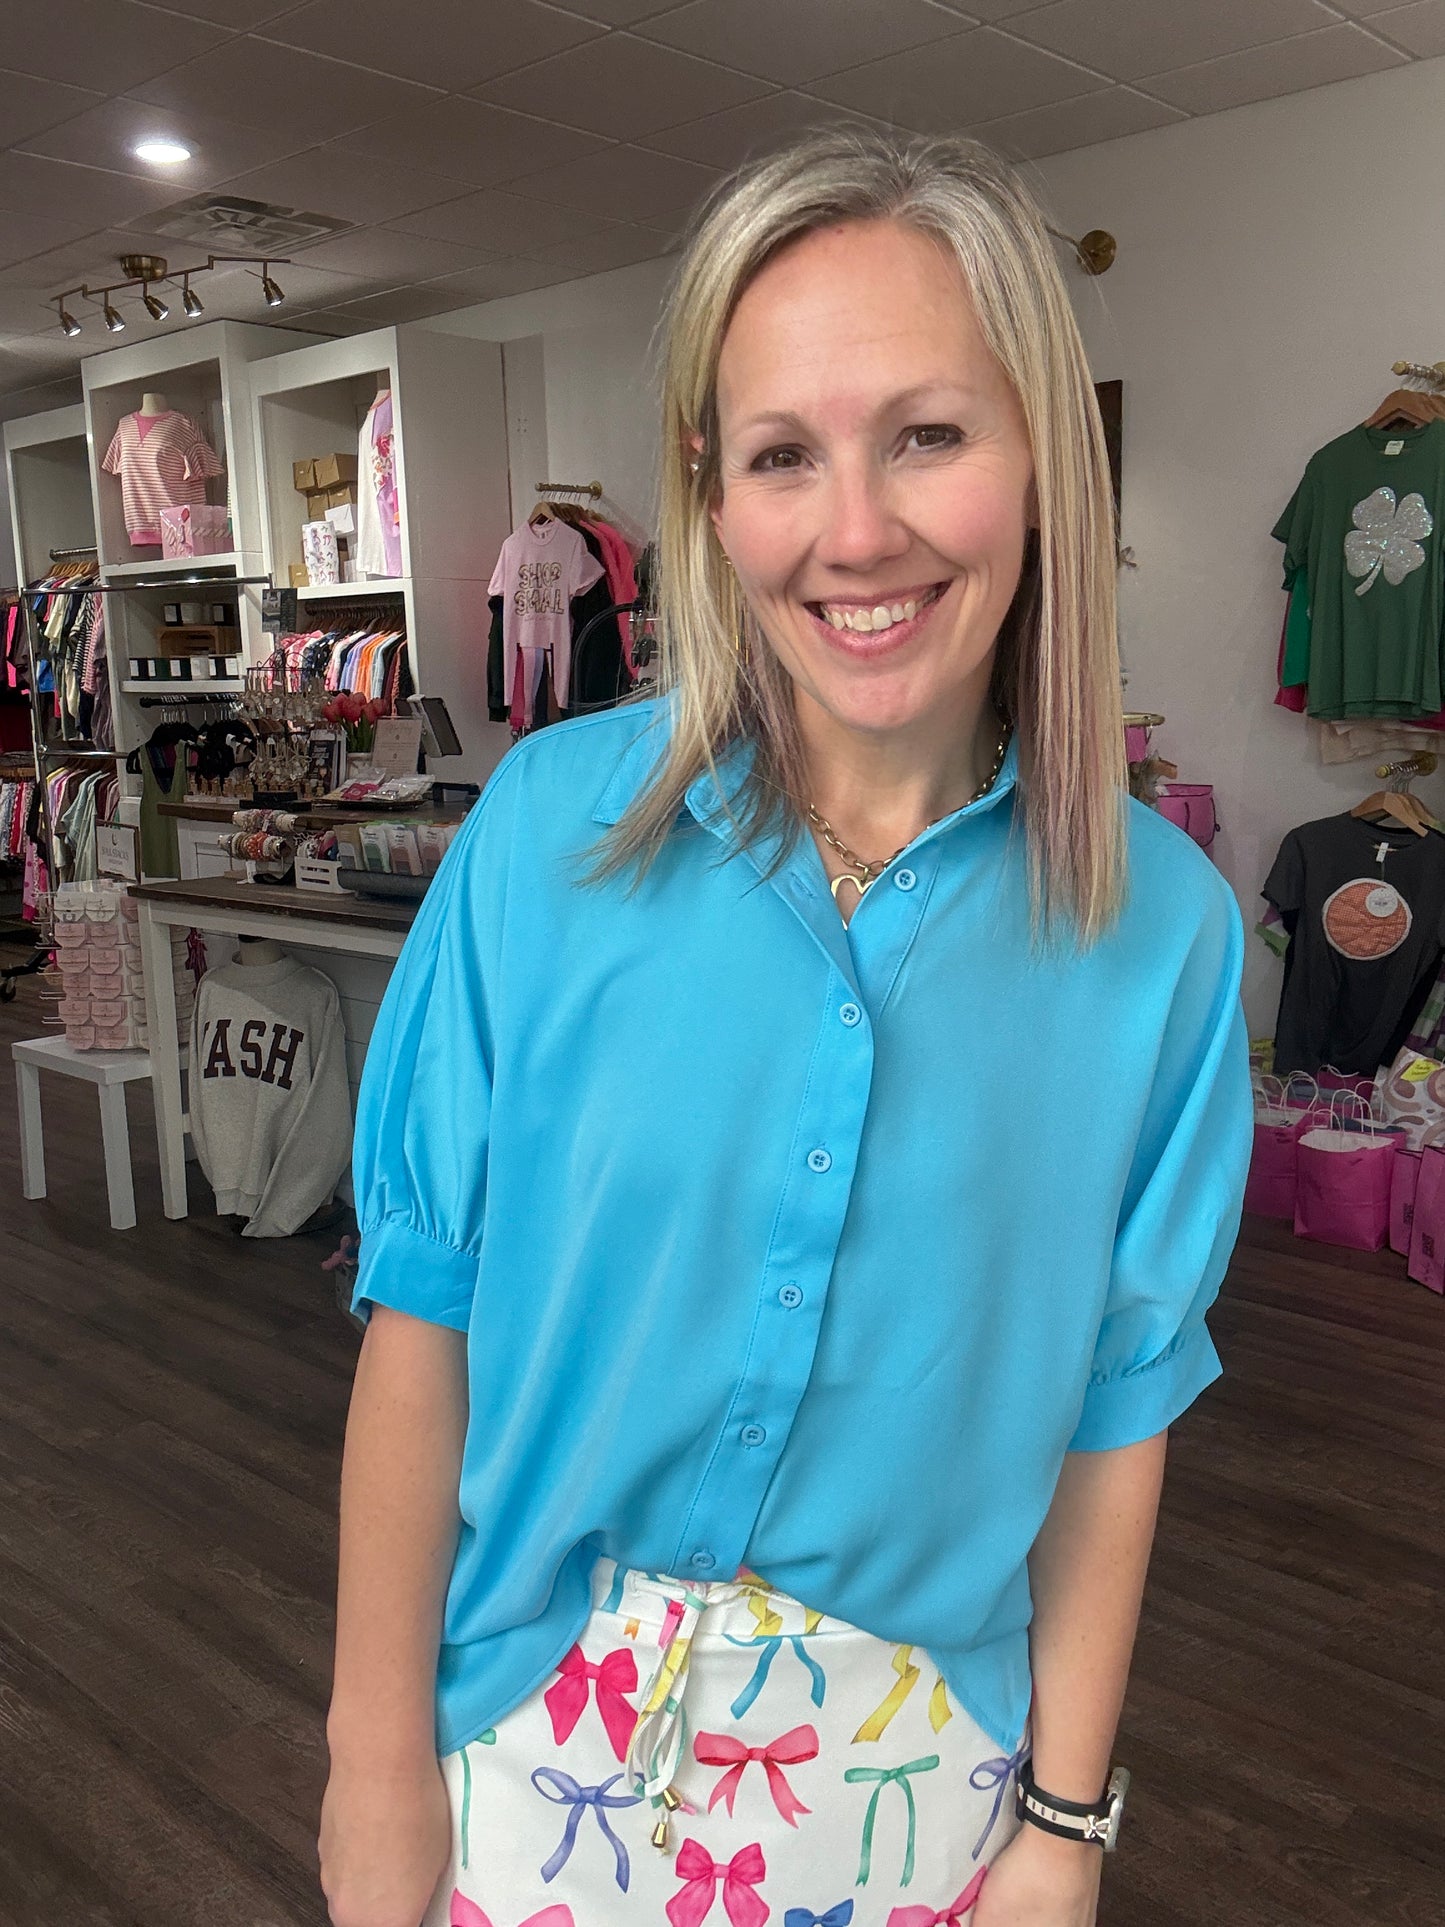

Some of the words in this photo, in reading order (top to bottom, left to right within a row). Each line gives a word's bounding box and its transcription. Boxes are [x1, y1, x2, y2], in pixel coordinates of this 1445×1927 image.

[518, 562, 561, 590] SHOP
[513, 588, 565, 616] SMALL
[203, 1019, 304, 1090] ASH
